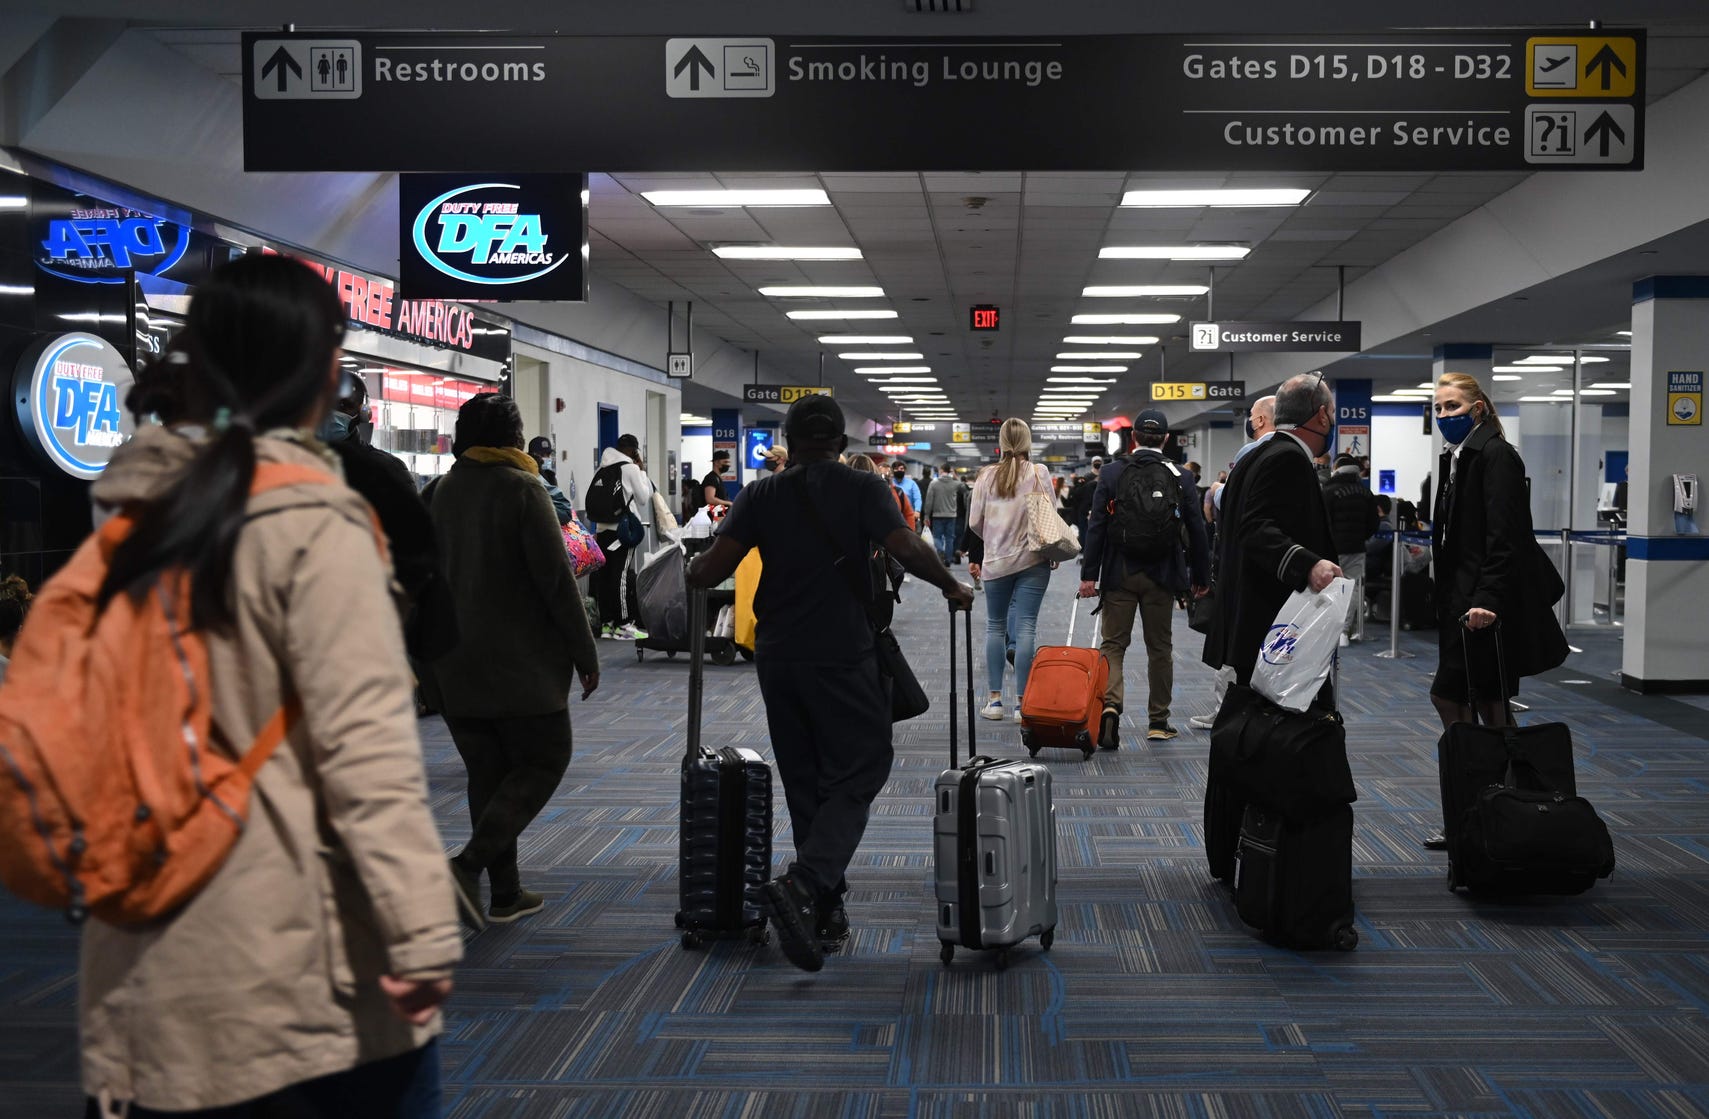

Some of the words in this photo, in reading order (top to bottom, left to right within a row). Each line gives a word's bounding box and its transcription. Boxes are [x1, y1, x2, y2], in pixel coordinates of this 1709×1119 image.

[375, 57, 546, 82] Restrooms
[788, 55, 929, 87] Smoking
[943, 56, 1063, 87] Lounge
[1182, 54, 1277, 79] Gates
[1290, 55, 1358, 82] D15,
[1367, 55, 1427, 79] D18
[1454, 55, 1512, 79] D32
[1223, 121, 1381, 145] Customer
[1393, 120, 1511, 145] Service
[441, 203, 482, 214] DUTY
[482, 203, 519, 214] FREE
[438, 214, 548, 264] DFA
[488, 253, 553, 265] AMERICAS
[338, 270, 394, 330] FREE
[397, 300, 475, 350] AMERICAS
[974, 310, 997, 328] EXIT
[1222, 331, 1288, 343] Customer
[1291, 331, 1342, 343] Service
[56, 361, 81, 378] DUTY
[81, 365, 104, 381] FREE
[1672, 373, 1699, 384] HAND
[747, 388, 778, 400] Gate
[1154, 385, 1185, 398] D15
[1208, 385, 1241, 397] Gate
[1669, 384, 1702, 392] SANITIZER
[53, 376, 120, 446] DFA
[1340, 407, 1367, 419] D15
[715, 429, 736, 439] D18
